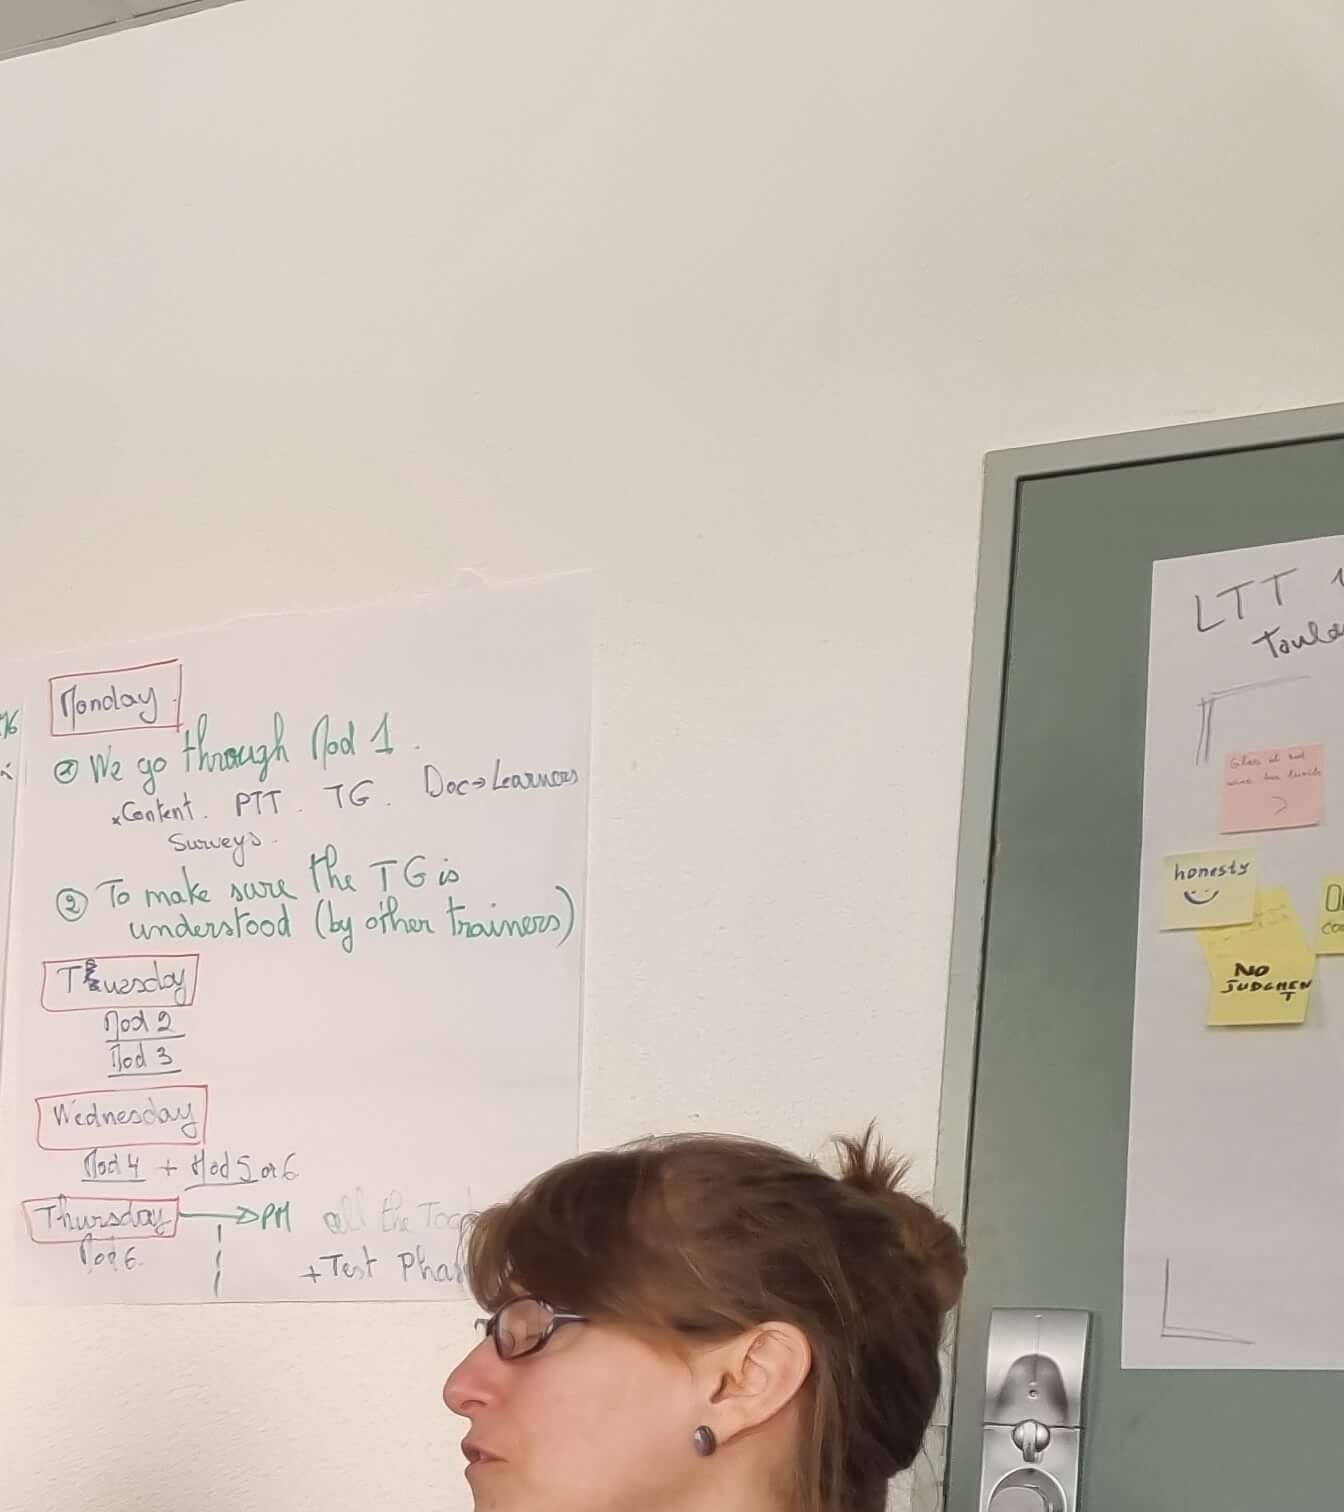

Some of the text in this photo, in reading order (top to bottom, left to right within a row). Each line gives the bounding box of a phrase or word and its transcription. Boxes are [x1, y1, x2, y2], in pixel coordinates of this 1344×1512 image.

[1195, 567, 1298, 632] LTT
[60, 684, 157, 731] Monday
[90, 744, 123, 783] We
[138, 757, 167, 795] go
[183, 711, 289, 782] through
[96, 878, 130, 908] To
[145, 866, 211, 908] make
[230, 879, 298, 902] sure
[310, 844, 357, 892] the
[369, 855, 426, 891] TG
[439, 857, 460, 885] is
[1174, 860, 1250, 880] honesty
[129, 903, 292, 939] understood
[365, 896, 435, 934] other
[1234, 962, 1270, 977] NO
[156, 1047, 173, 1065] 3
[53, 1098, 198, 1139] Wednesday
[33, 1193, 172, 1238] Thursday
